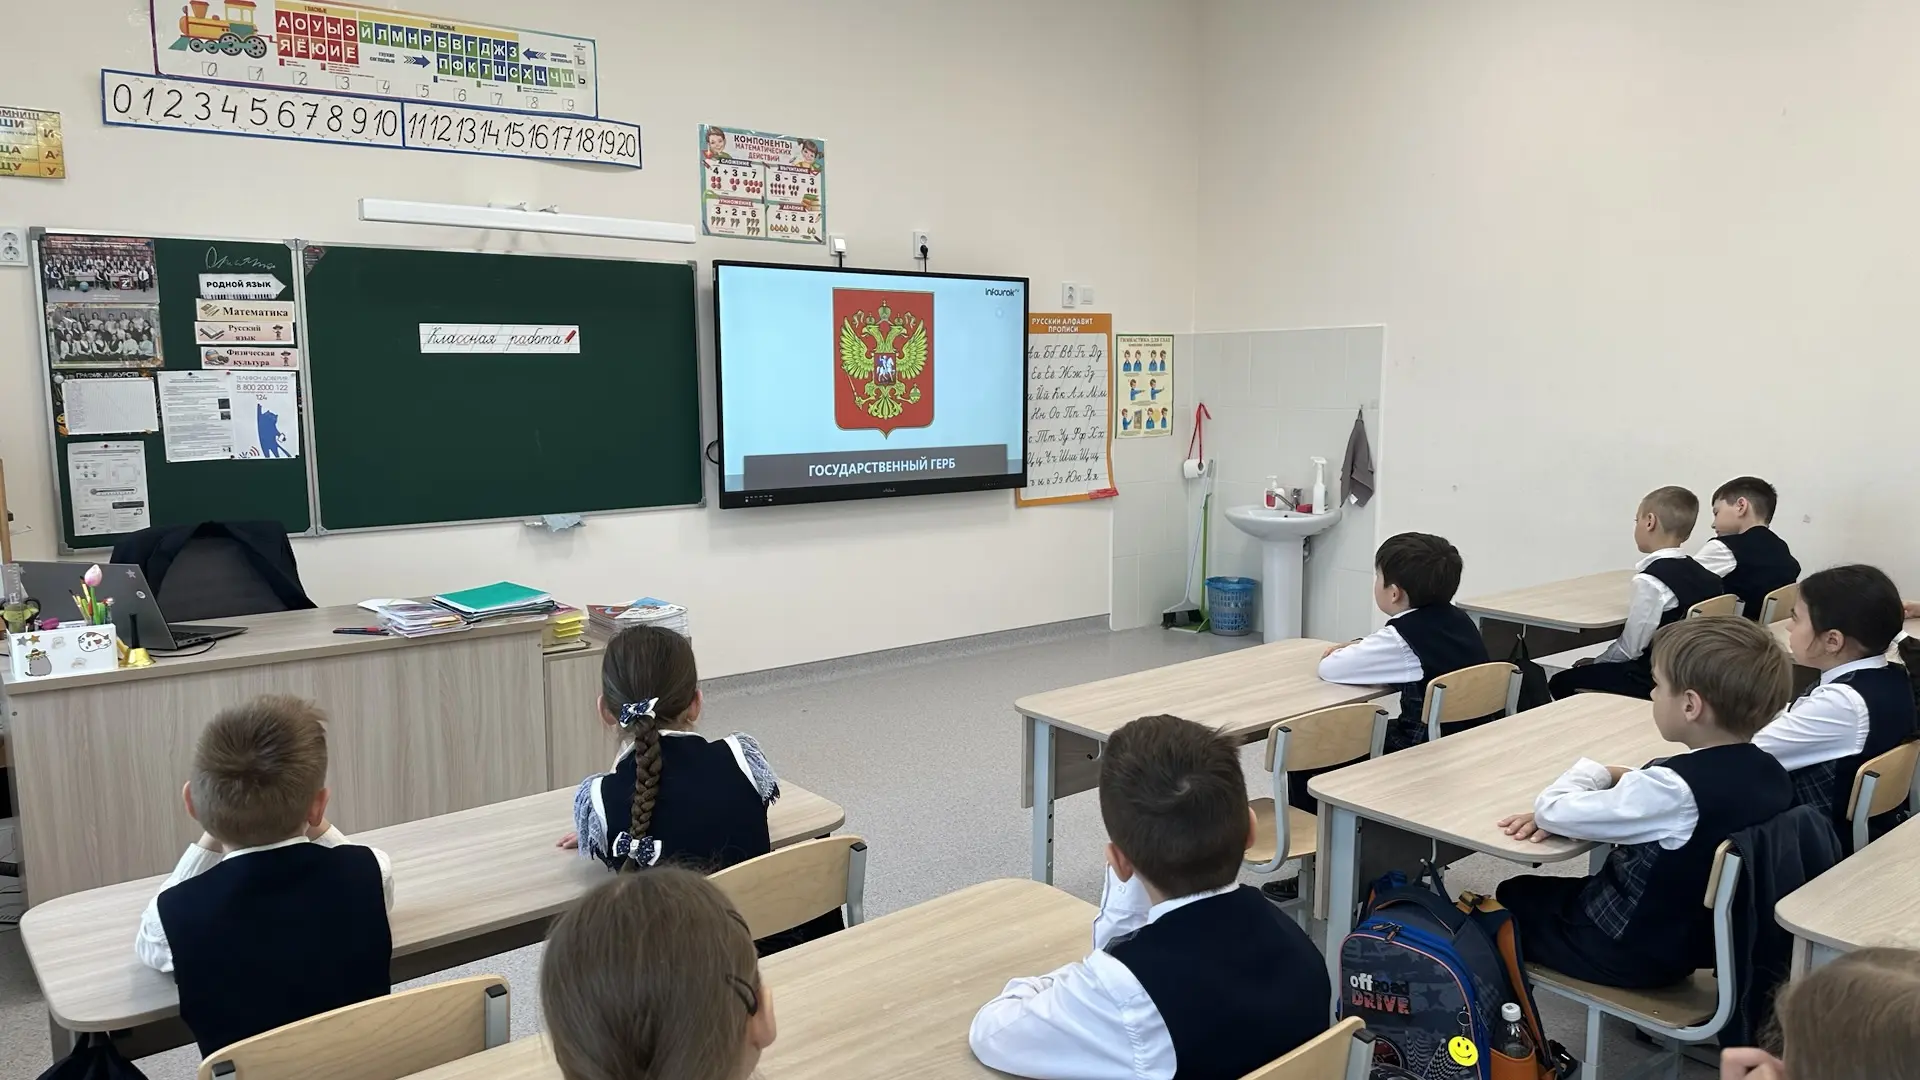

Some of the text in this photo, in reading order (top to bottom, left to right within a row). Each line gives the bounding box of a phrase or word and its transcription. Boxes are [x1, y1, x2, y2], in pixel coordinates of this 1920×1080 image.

[278, 17, 517, 57] А О У Ы Э Й Л М Н Р Б В Г Д Ж З
[280, 39, 356, 58] Я Ё Ю И Е
[439, 59, 448, 69] П
[453, 60, 463, 71] Ф
[468, 62, 476, 73] К
[482, 64, 490, 74] Т
[494, 66, 505, 76] Ш
[509, 68, 518, 77] С
[523, 69, 531, 79] Х
[536, 70, 546, 83] Ц
[550, 72, 559, 82] Ч
[563, 73, 574, 86] Щ
[207, 62, 574, 111] 0 1 2 3 4 5 6 7 8 9
[113, 84, 397, 137] 0 1 2 3 4 5 6 7 8 9 10
[408, 112, 636, 157] 11 12 13 14 15 16 17 18 19 20
[734, 135, 792, 149] КОМПОНЕНТЫ
[736, 143, 791, 155] МАТЕМАТИЧЕСКИХ
[45, 151, 56, 159] А
[748, 152, 779, 161] ДЕЙСТВИЙ
[713, 167, 719, 175] 4
[716, 207, 721, 215] 3
[732, 208, 737, 216] 2
[207, 280, 243, 289] РОДНОЙ
[223, 307, 288, 317] Математика
[228, 324, 261, 332] Русский
[1032, 317, 1060, 325] РУССКИЙ
[428, 326, 562, 351] Классная работа
[809, 456, 956, 478] ГОСУДАРСТВЕННЫЙ ГЕРБ
[1352, 989, 1410, 1014] DRIVE
